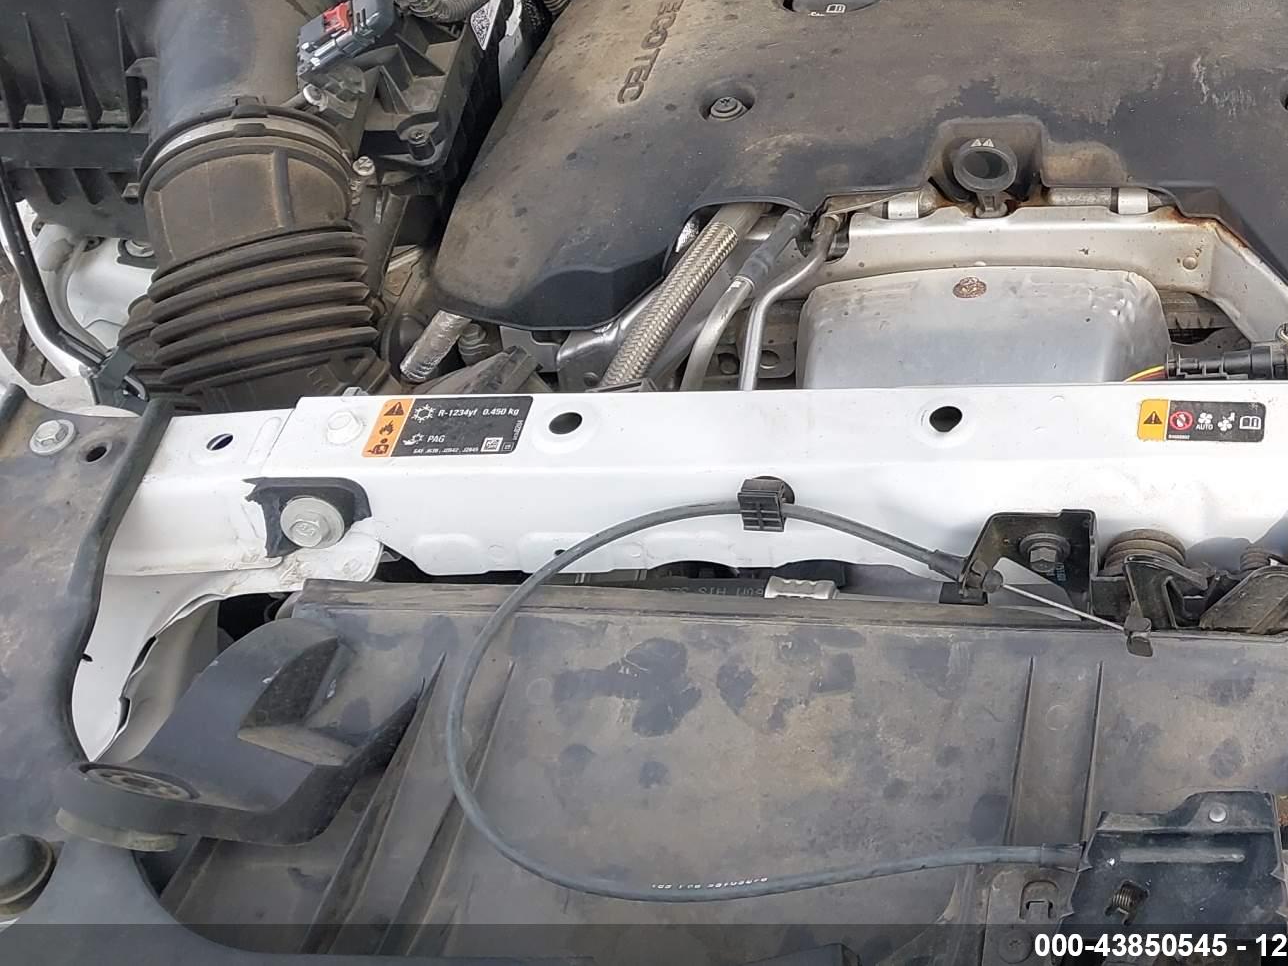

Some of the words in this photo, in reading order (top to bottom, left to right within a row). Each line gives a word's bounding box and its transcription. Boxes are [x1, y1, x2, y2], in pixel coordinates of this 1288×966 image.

[437, 407, 479, 418] R-1234yf
[482, 407, 507, 416] 0.450
[507, 407, 520, 417] kg
[427, 435, 446, 443] PAG
